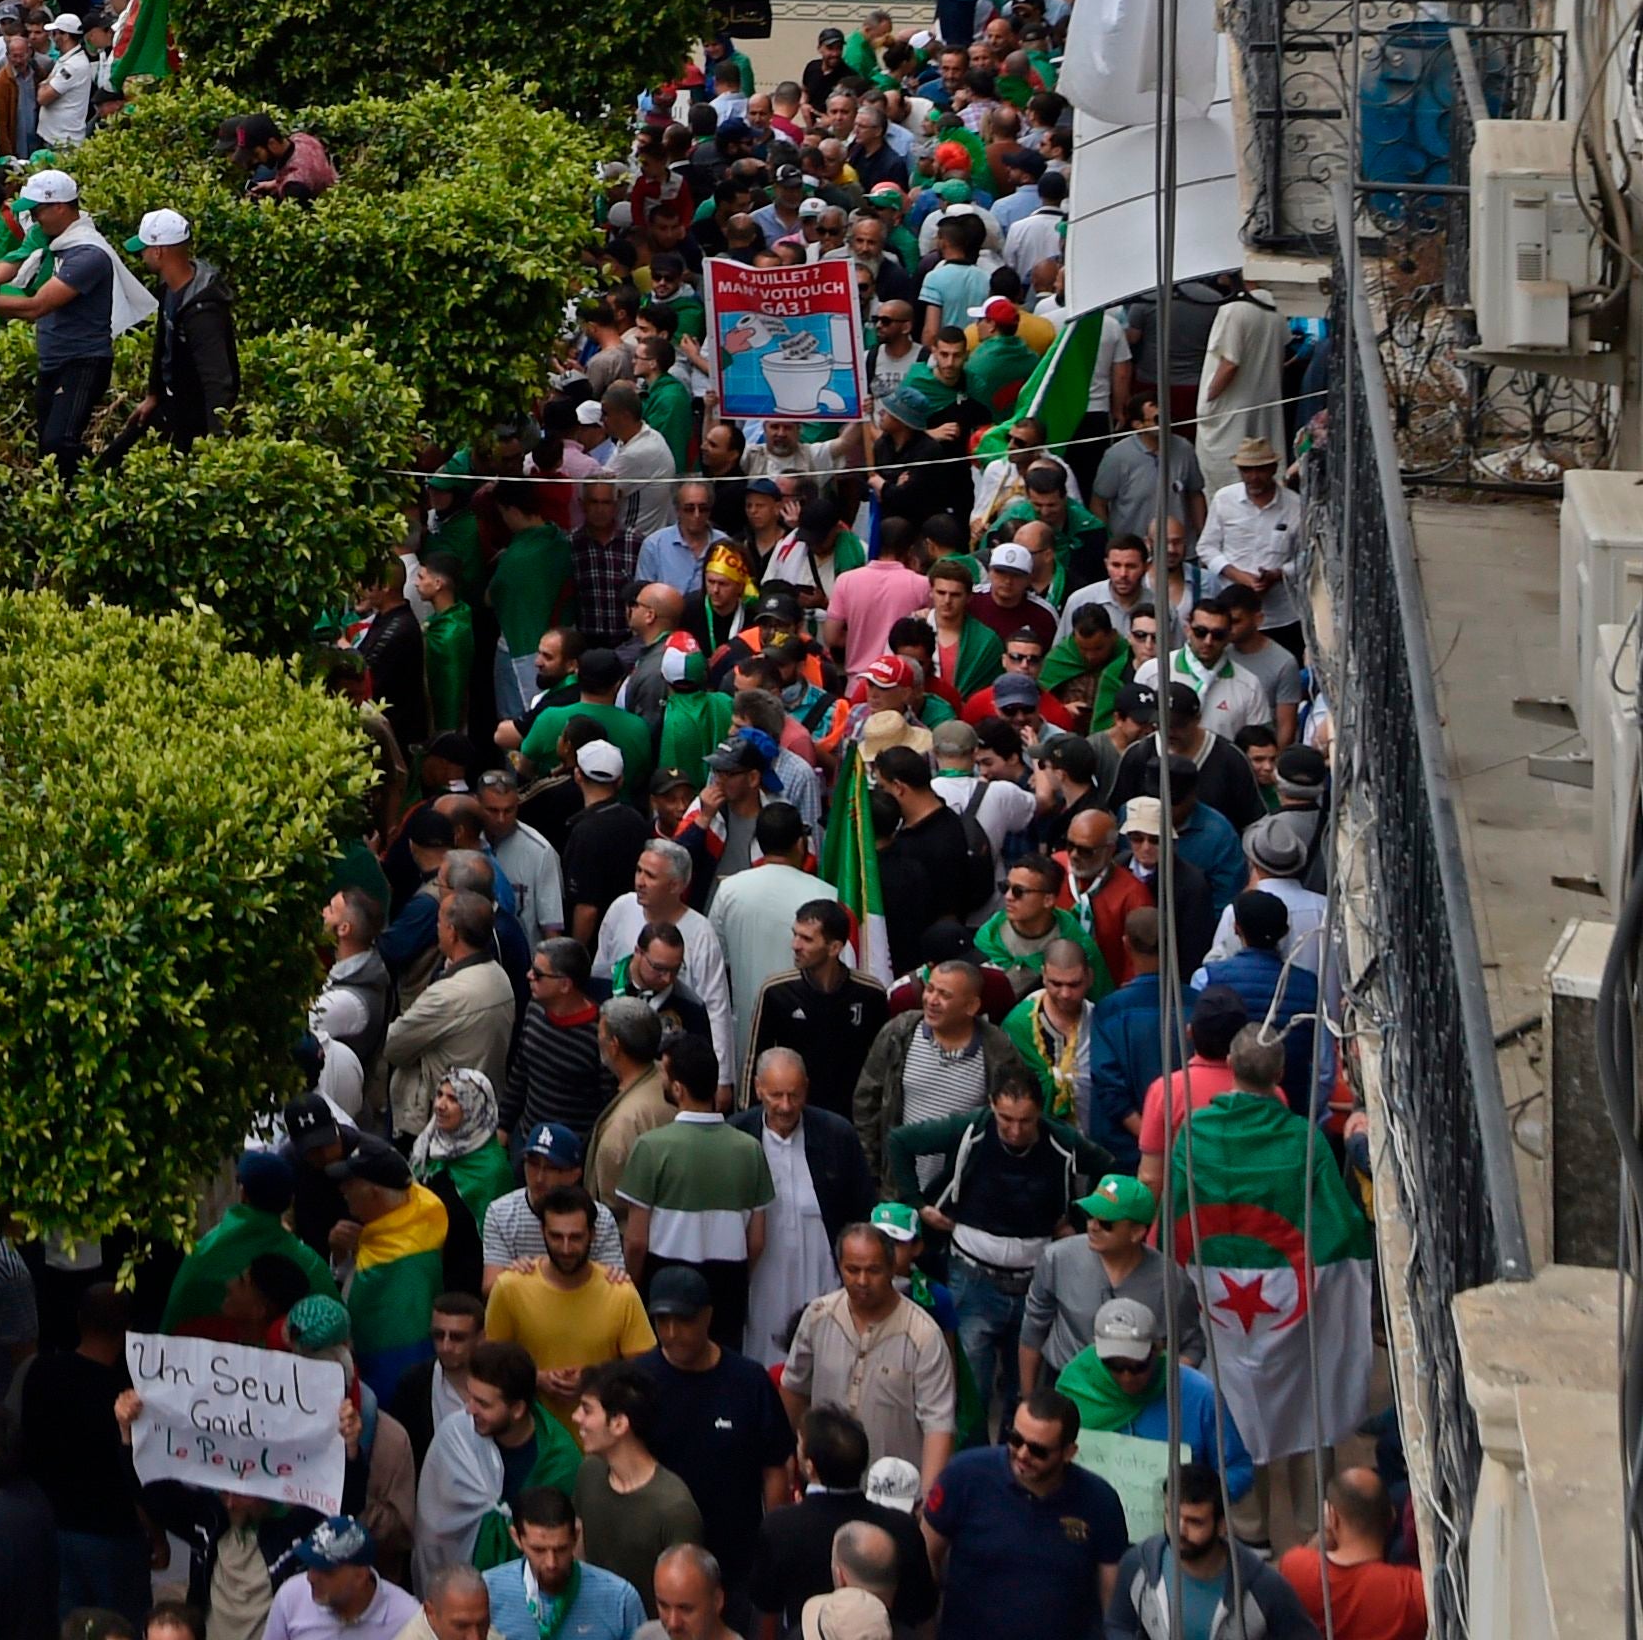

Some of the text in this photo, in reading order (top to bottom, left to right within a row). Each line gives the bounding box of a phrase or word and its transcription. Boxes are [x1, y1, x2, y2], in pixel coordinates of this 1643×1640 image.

[738, 268, 821, 285] 4 JUILLET ?
[717, 281, 845, 300] MAN' VOTIOUCH
[760, 299, 811, 316] GA3 !
[132, 1341, 318, 1415] Un Seul
